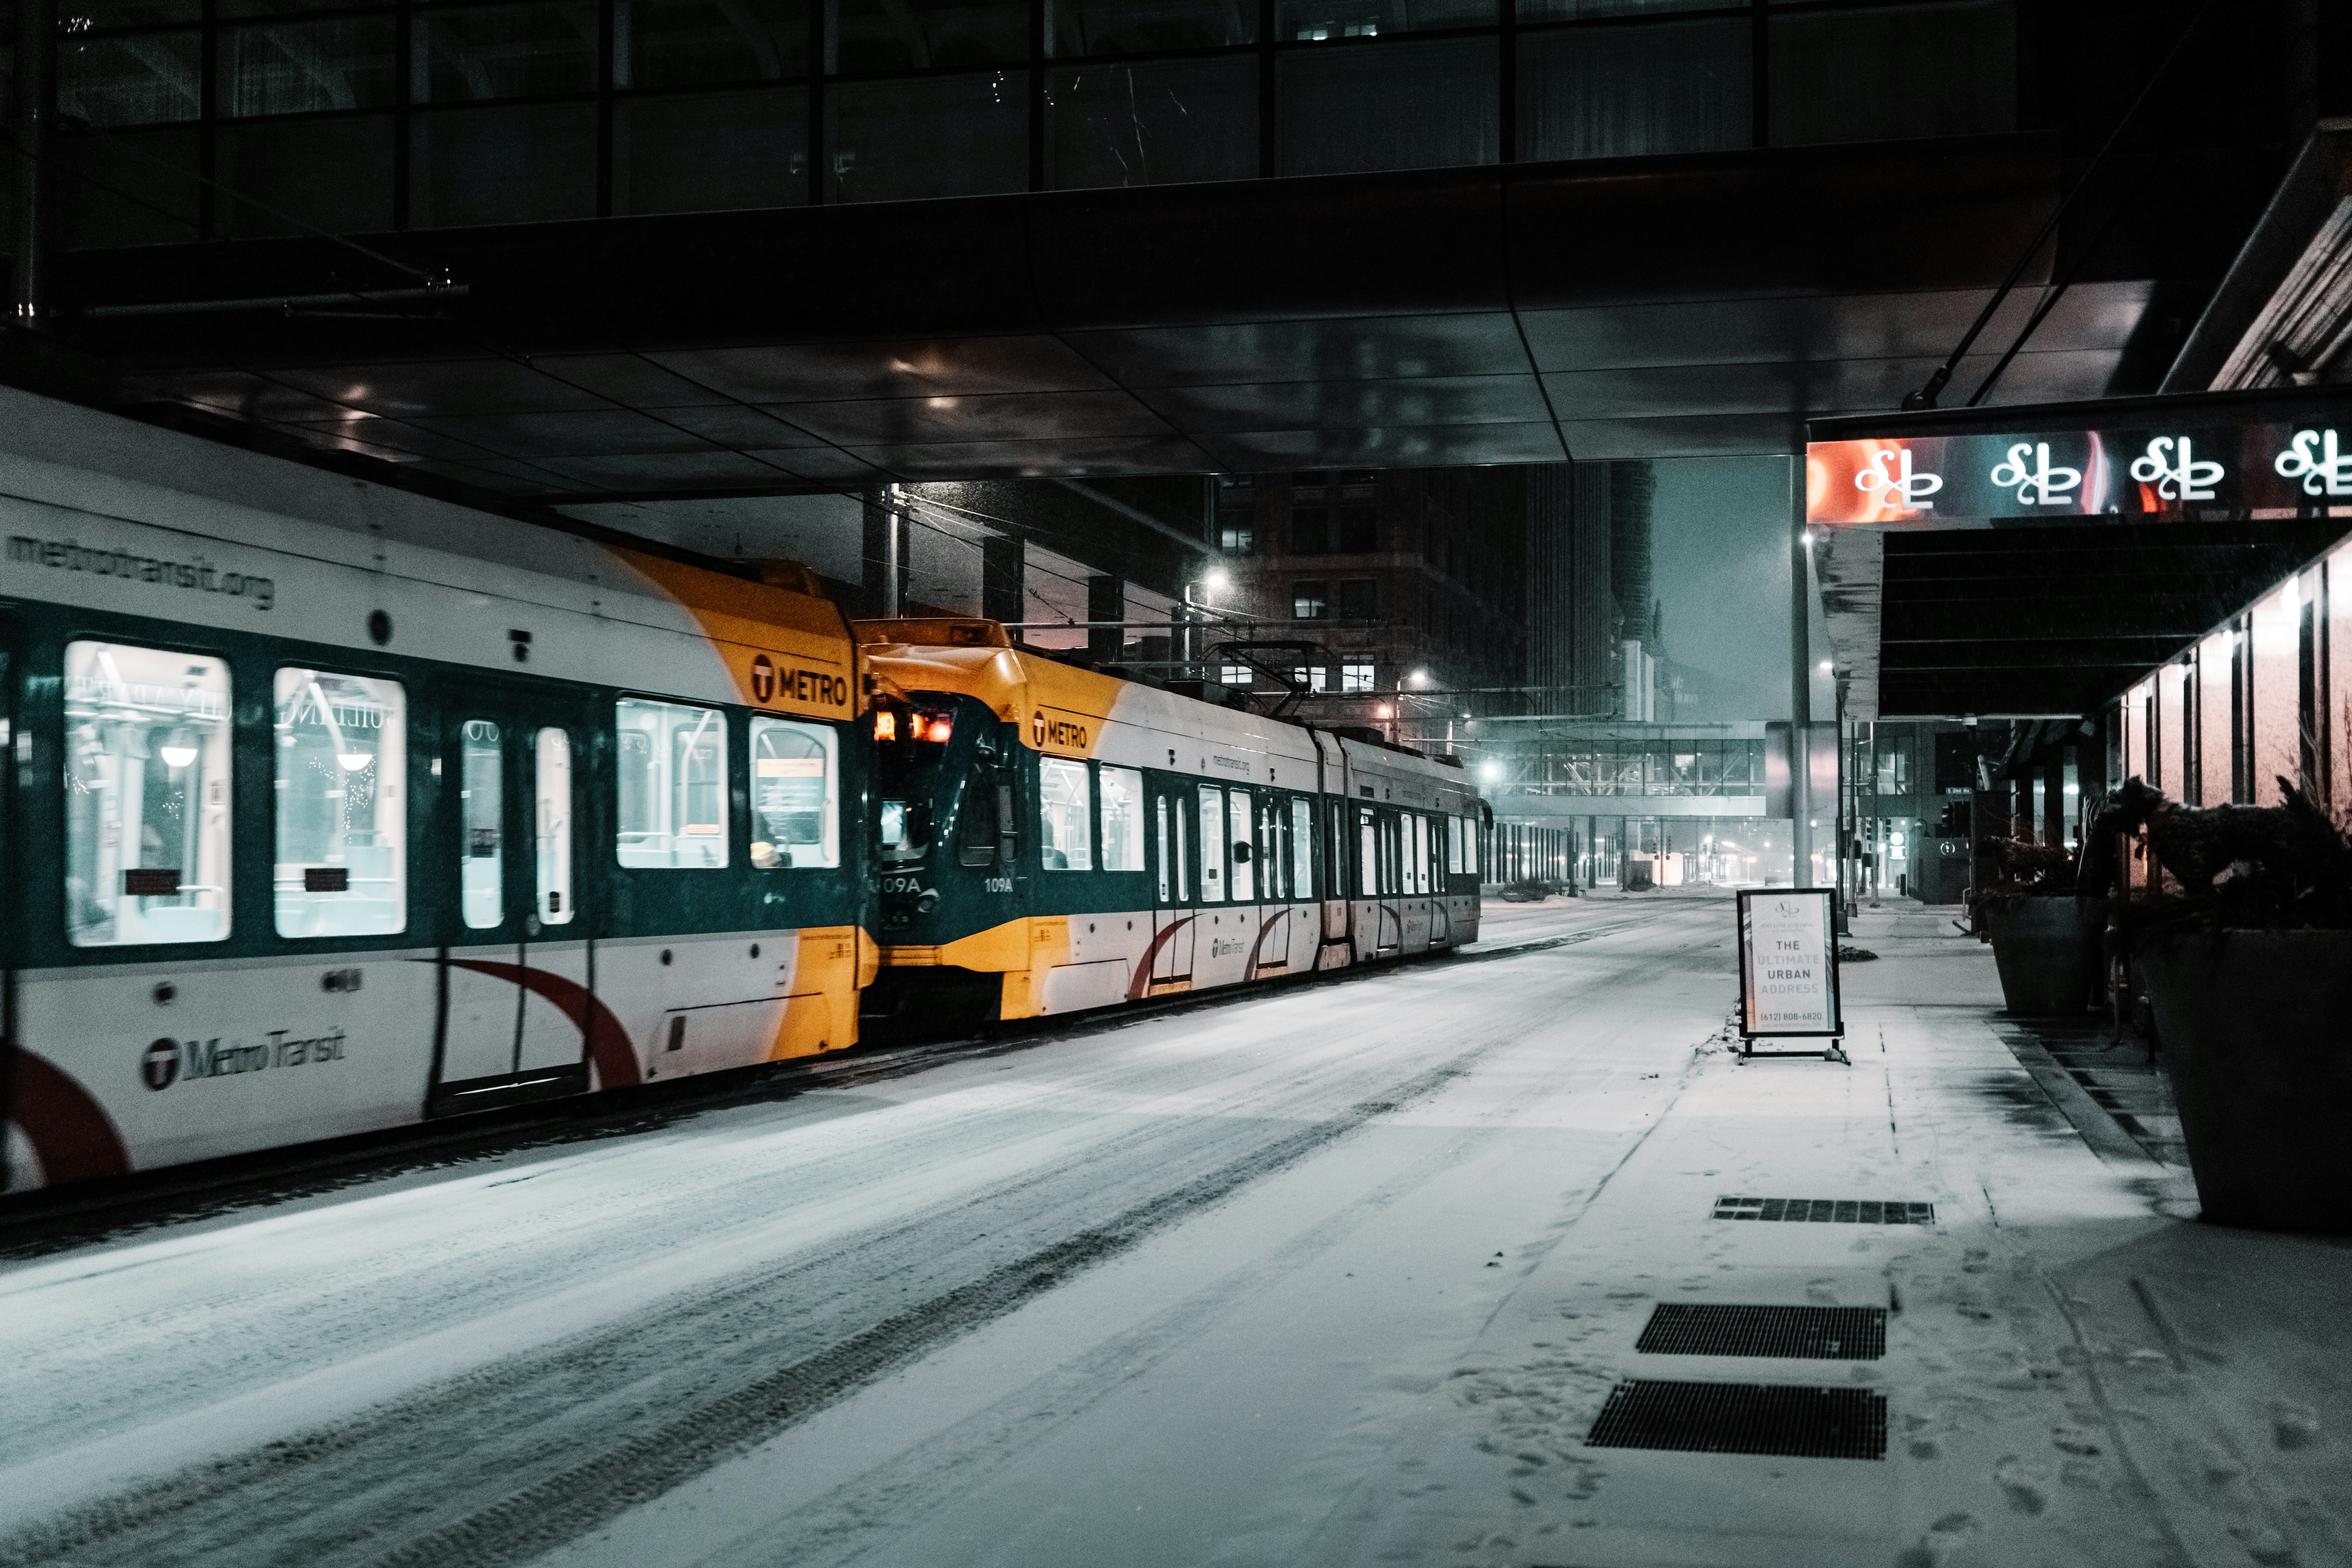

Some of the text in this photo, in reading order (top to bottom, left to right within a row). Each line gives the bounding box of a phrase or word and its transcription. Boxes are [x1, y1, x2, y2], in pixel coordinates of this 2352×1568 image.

[6, 535, 274, 611] metrotransit.org
[779, 667, 847, 706] METRO
[1048, 720, 1087, 748] METRO
[1214, 755, 1250, 775] metrotransit.org
[984, 878, 1013, 892] 109A
[1776, 941, 1800, 950] THE
[1757, 954, 1819, 965] ULTIMATE
[1768, 970, 1811, 979] URBAN
[1761, 984, 1819, 994] ADDRESS
